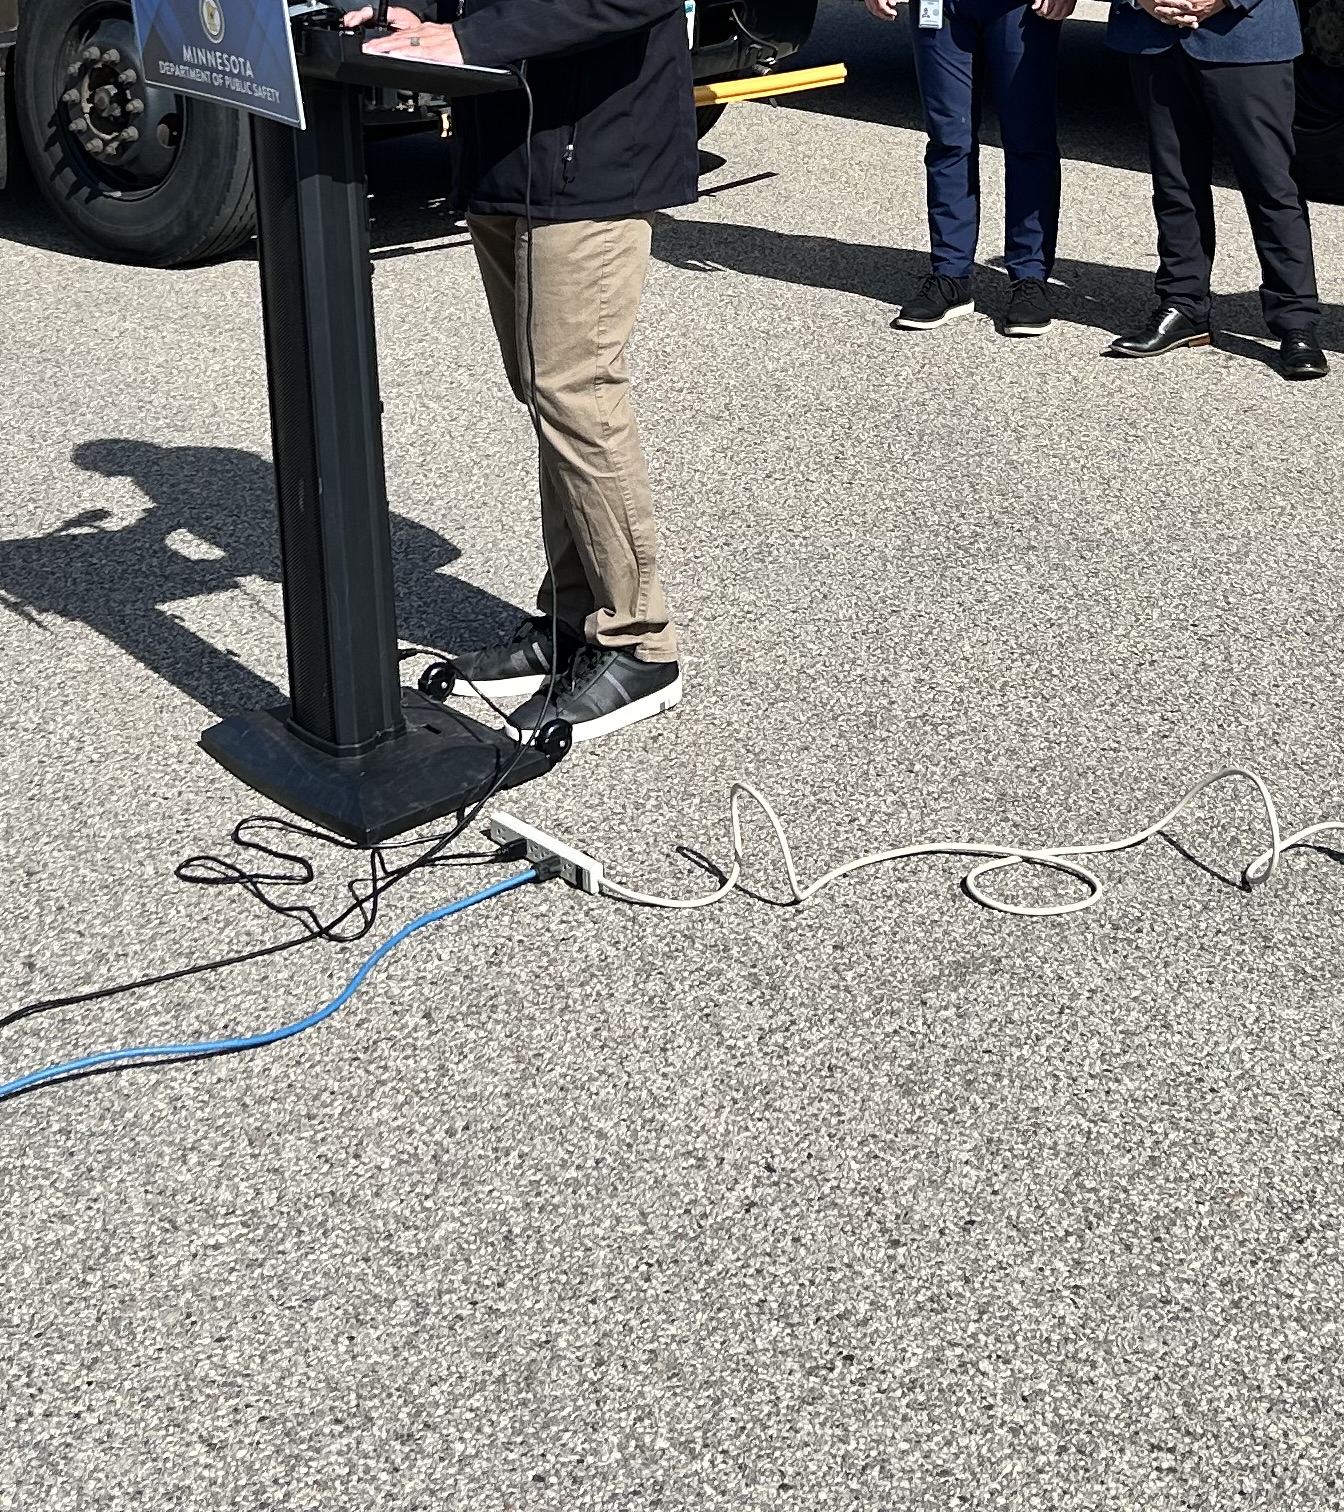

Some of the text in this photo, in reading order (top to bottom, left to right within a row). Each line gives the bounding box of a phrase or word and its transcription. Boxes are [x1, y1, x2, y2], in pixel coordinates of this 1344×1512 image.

[182, 44, 254, 78] MINNESOTA
[158, 60, 280, 103] DEPARTMENT OF PUBLIC SAFETY
